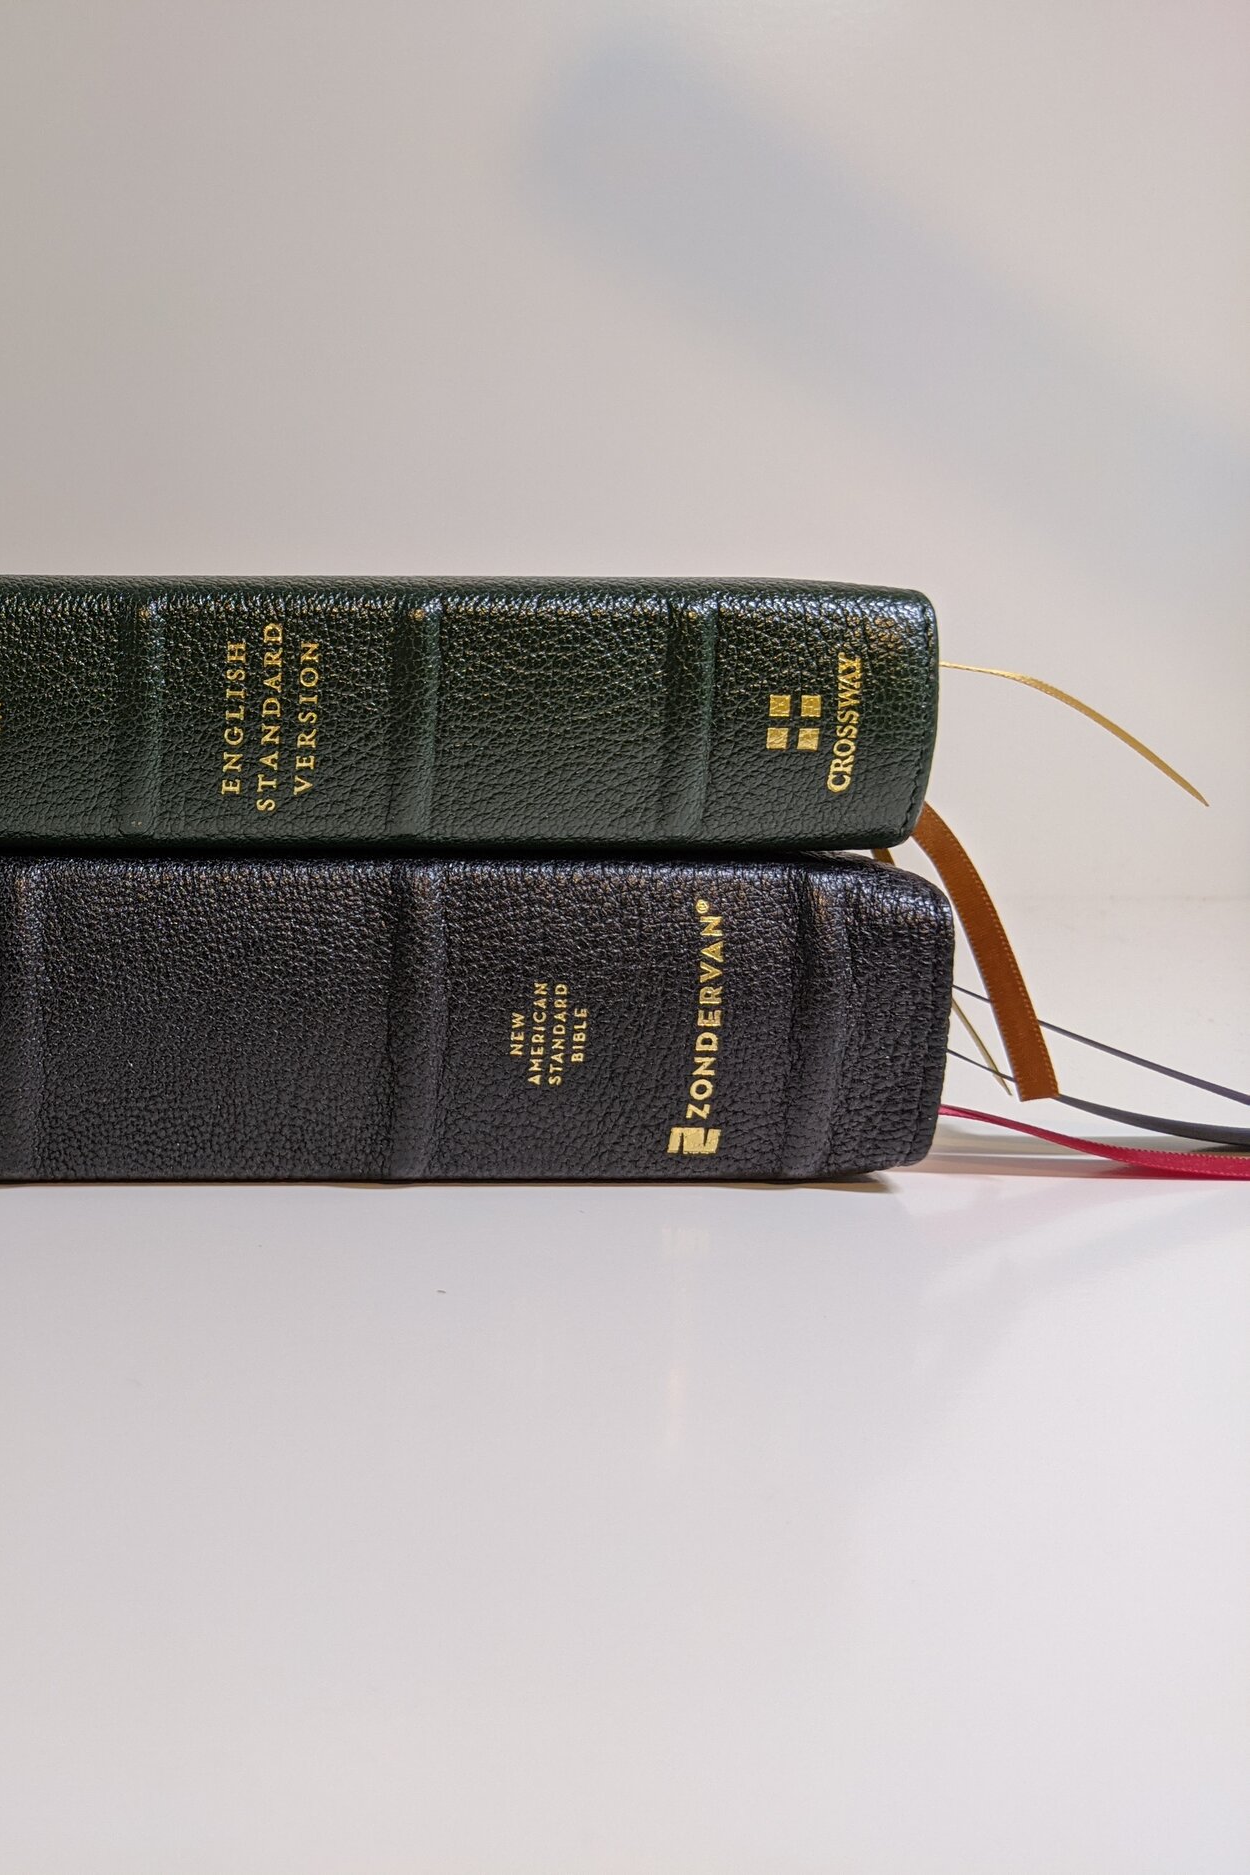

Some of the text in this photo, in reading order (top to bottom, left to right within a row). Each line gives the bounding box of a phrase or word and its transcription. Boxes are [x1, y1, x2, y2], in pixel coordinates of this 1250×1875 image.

[221, 641, 247, 795] ENGLISH
[256, 622, 284, 812] STANDARD
[293, 641, 320, 794] VERSION
[826, 651, 863, 793] CROSSWAY
[509, 1012, 526, 1057] NEW
[528, 983, 547, 1085] AMERICAN
[548, 984, 568, 1085] STANDARD
[570, 1010, 588, 1063] BIBLE
